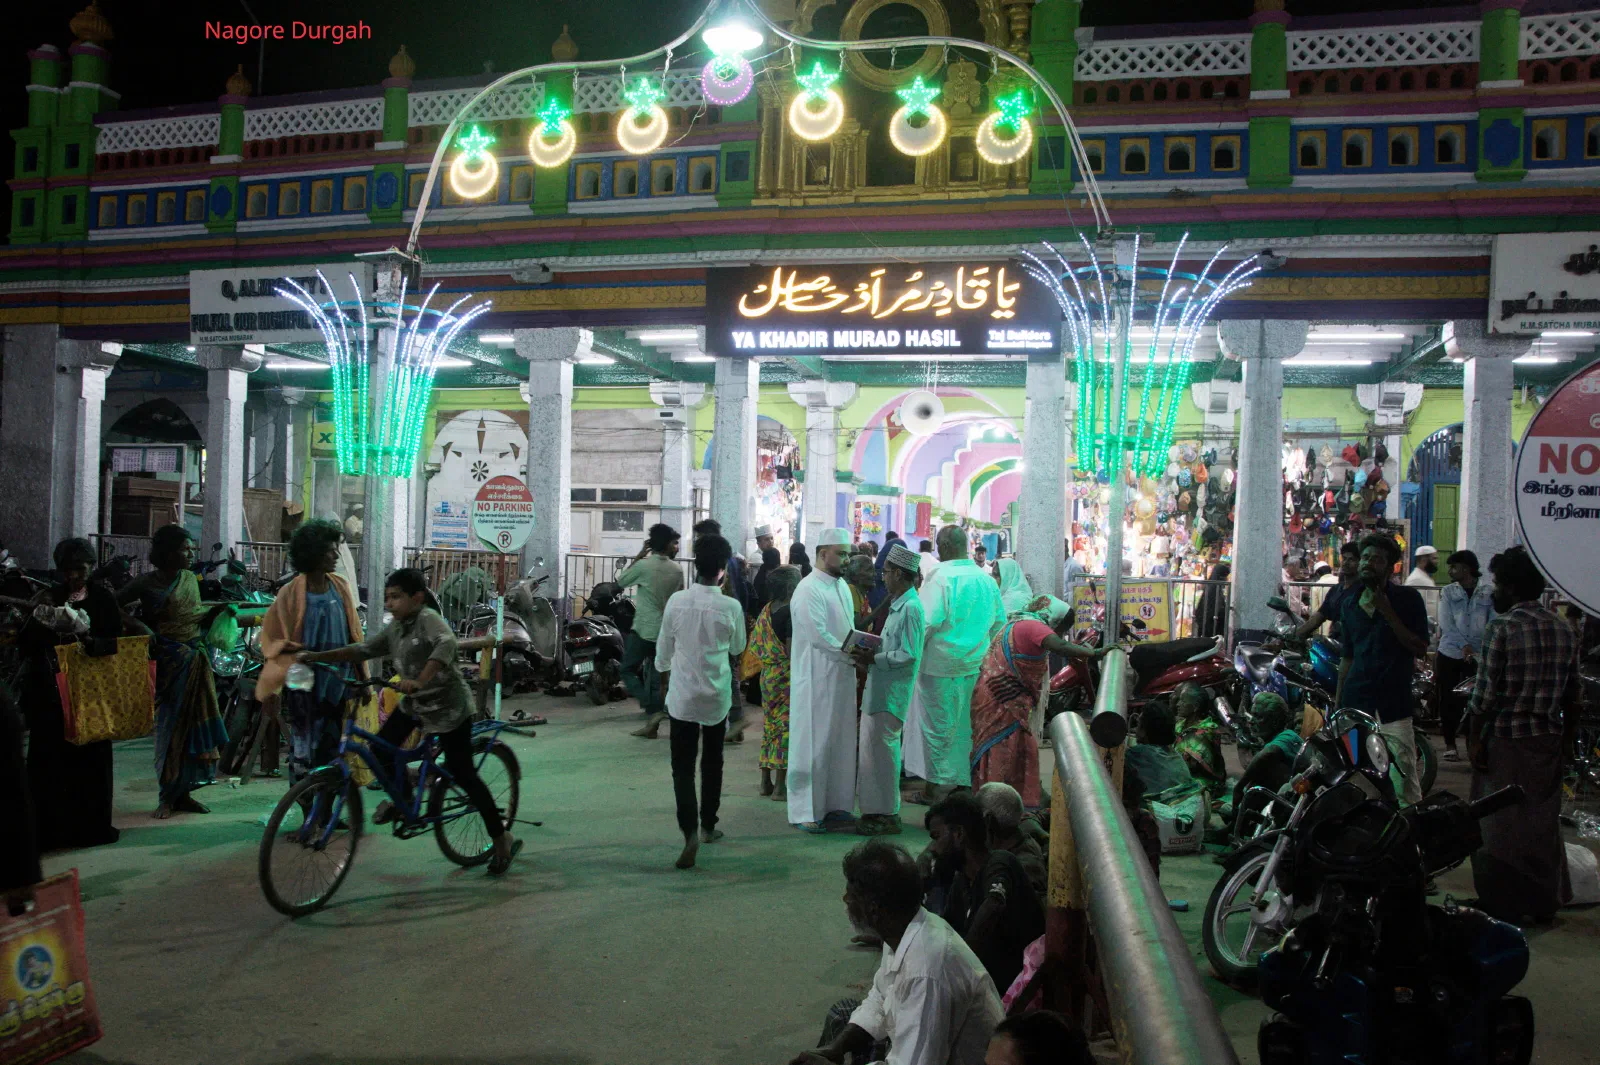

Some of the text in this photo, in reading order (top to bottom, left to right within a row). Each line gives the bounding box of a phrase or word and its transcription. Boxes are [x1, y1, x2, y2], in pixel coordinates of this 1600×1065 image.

[1573, 321, 1600, 330] MUBA
[731, 329, 961, 348] YA KHADIR MURAD HASIL
[1539, 442, 1600, 475] NO
[1523, 479, 1574, 498] இங்கு
[477, 502, 532, 512] NO PARKING
